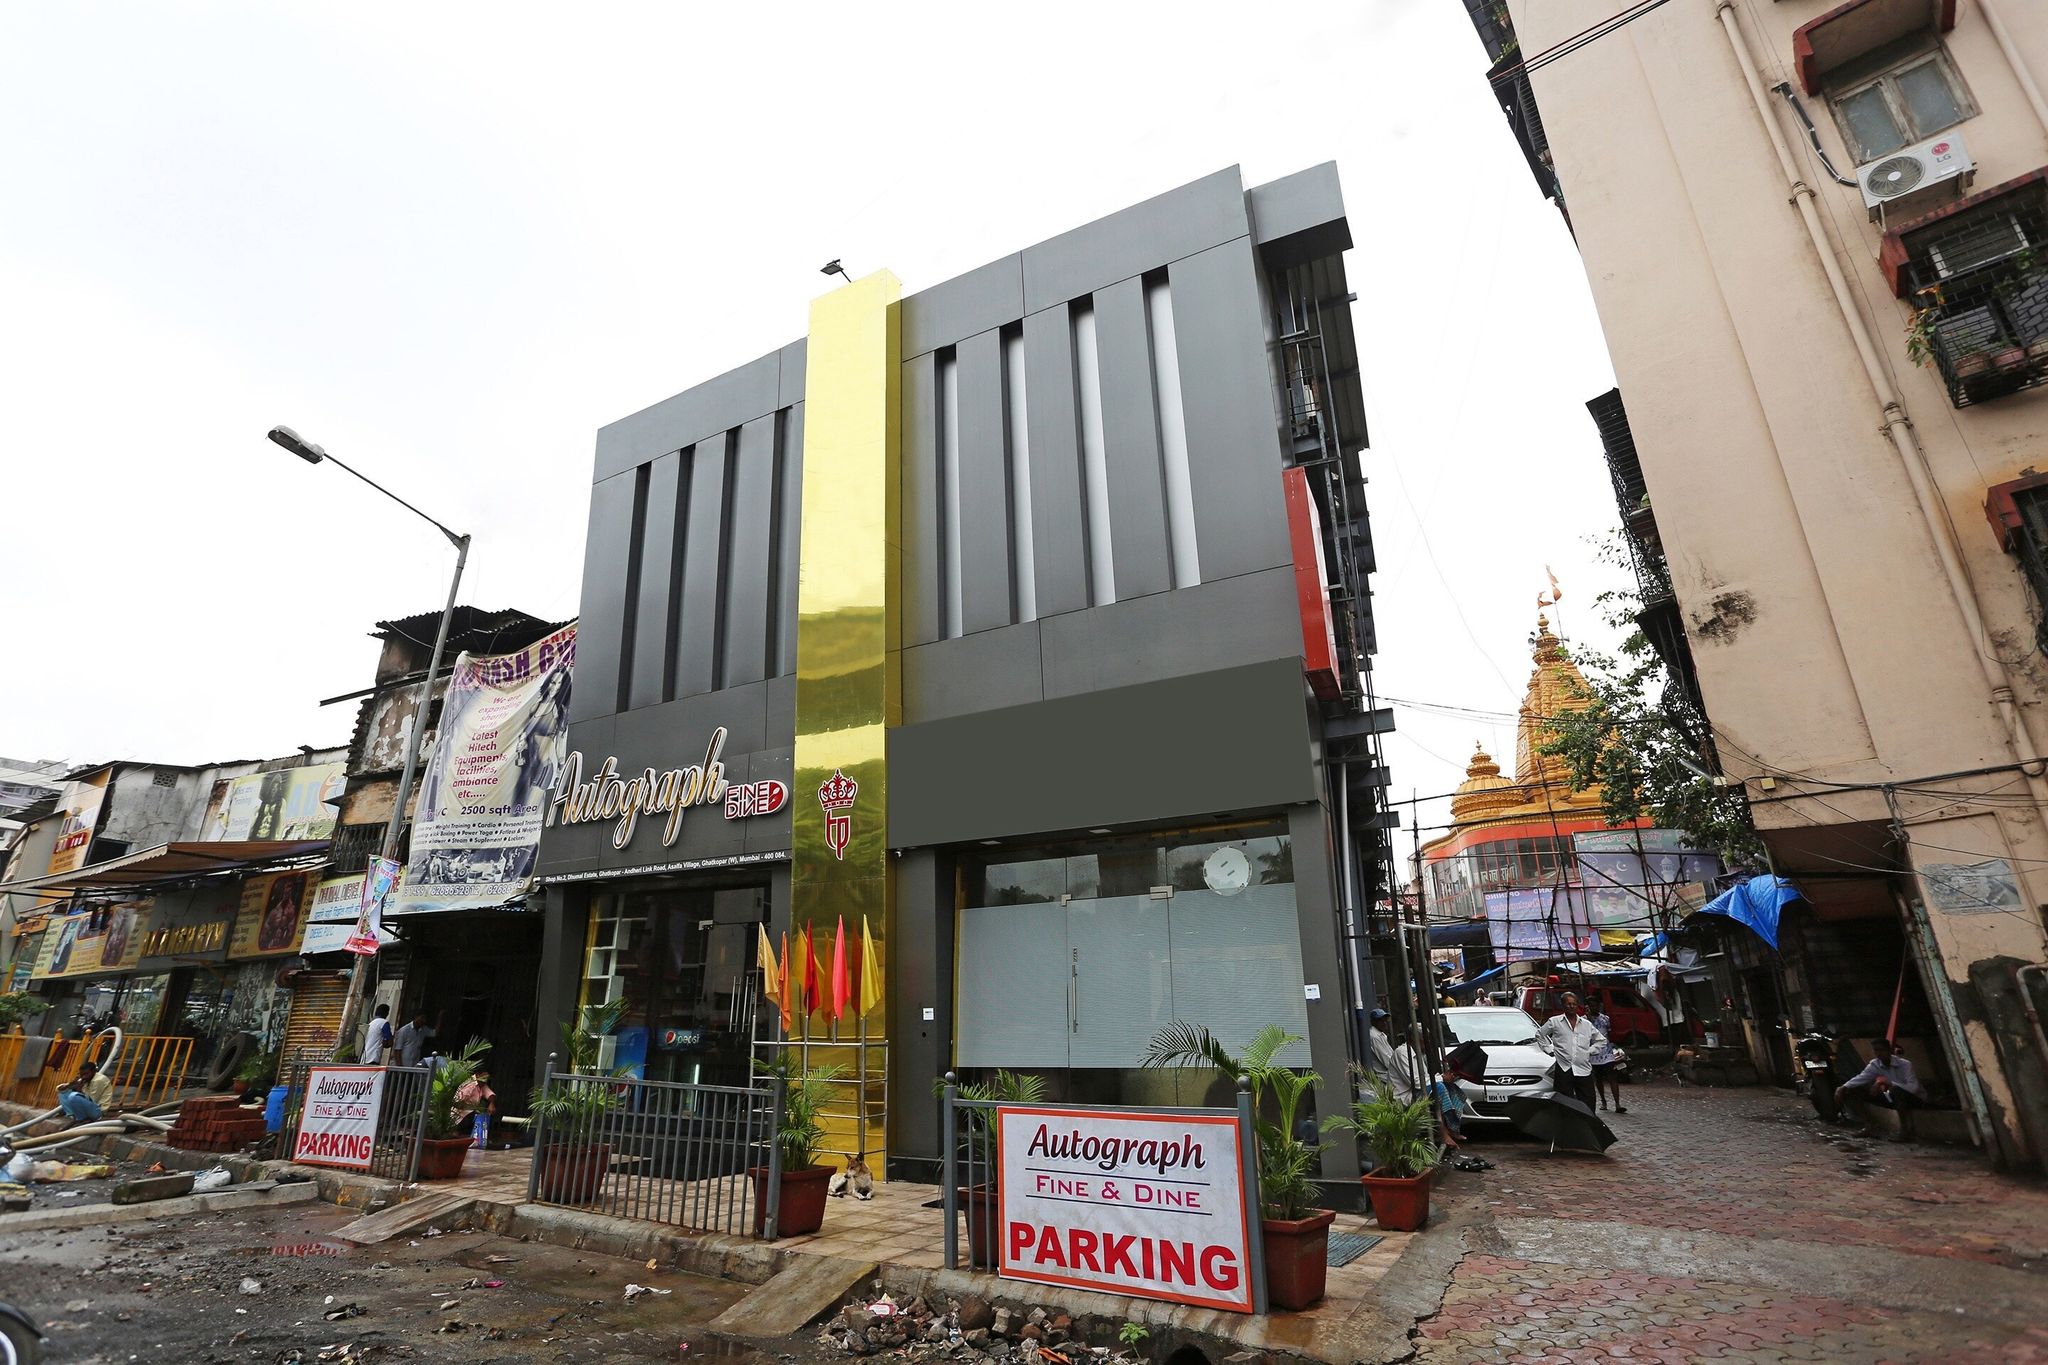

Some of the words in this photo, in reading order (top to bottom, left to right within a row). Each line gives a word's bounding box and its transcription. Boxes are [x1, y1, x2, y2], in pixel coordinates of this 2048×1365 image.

[1936, 153, 1951, 163] LG
[471, 730, 498, 741] Latest
[468, 741, 497, 752] Hitech
[452, 777, 498, 788] ambiance
[546, 726, 730, 850] Autograph
[725, 782, 768, 802] FINE
[460, 805, 486, 815] 2500
[488, 804, 511, 817] sqft
[513, 803, 538, 815] Area
[502, 820, 525, 828] Personal
[479, 829, 494, 837] Yoga
[599, 869, 621, 877] Ghatkopar
[624, 867, 642, 875] Andheri
[653, 864, 667, 872] Road,
[683, 861, 701, 869] Village,
[701, 858, 727, 867] Ghatkopar
[728, 856, 739, 865] (W),
[739, 854, 760, 862] Mumbai
[315, 1075, 374, 1100] Autograph
[314, 1104, 333, 1116] FINE
[335, 1105, 342, 1116] &
[346, 1105, 368, 1117] DINE
[297, 1132, 372, 1160] PARKING
[1027, 1123, 1206, 1175] Autograph
[1035, 1174, 1089, 1198] FINE
[1101, 1181, 1121, 1201] &
[1134, 1183, 1201, 1208] DINE
[1009, 1221, 1240, 1292] PARKING
